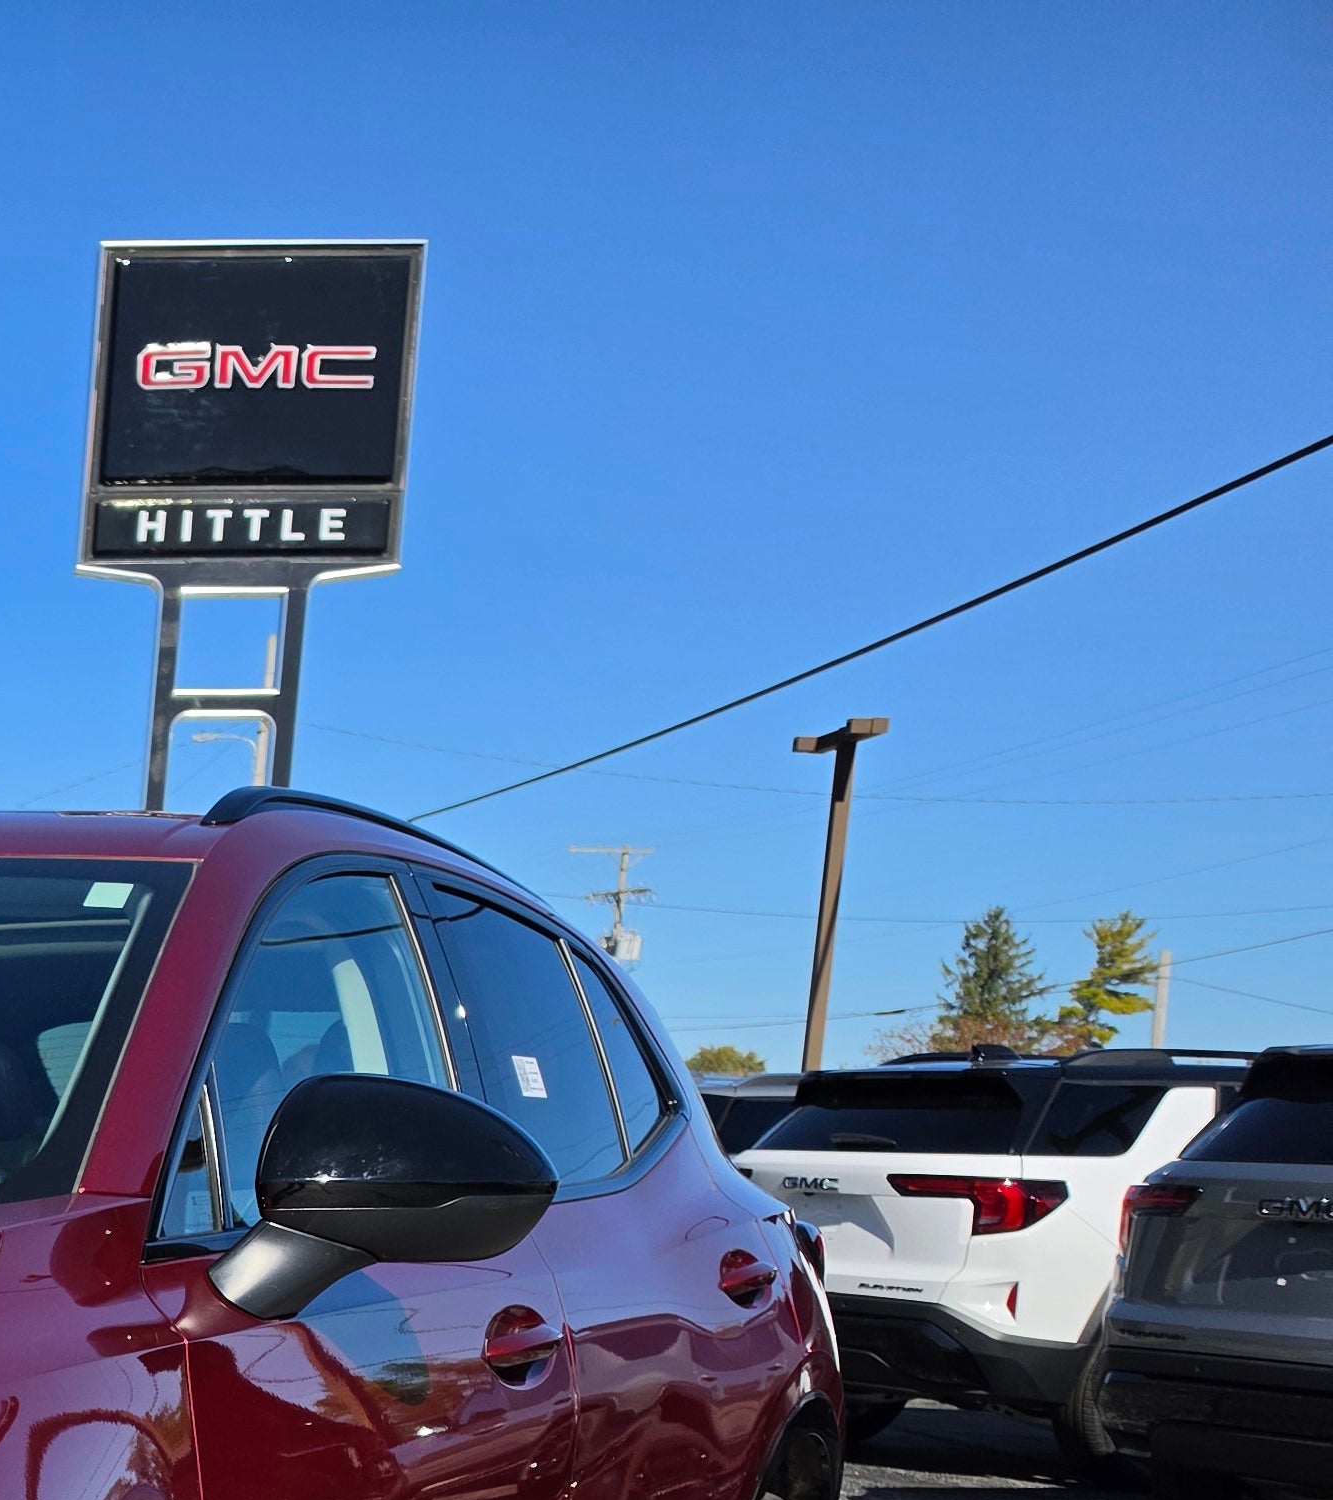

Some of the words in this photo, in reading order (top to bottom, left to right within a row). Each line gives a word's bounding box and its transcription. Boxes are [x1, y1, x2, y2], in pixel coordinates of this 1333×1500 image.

[137, 341, 377, 390] GMC
[137, 508, 347, 542] HITTLE
[783, 1176, 840, 1191] GMC
